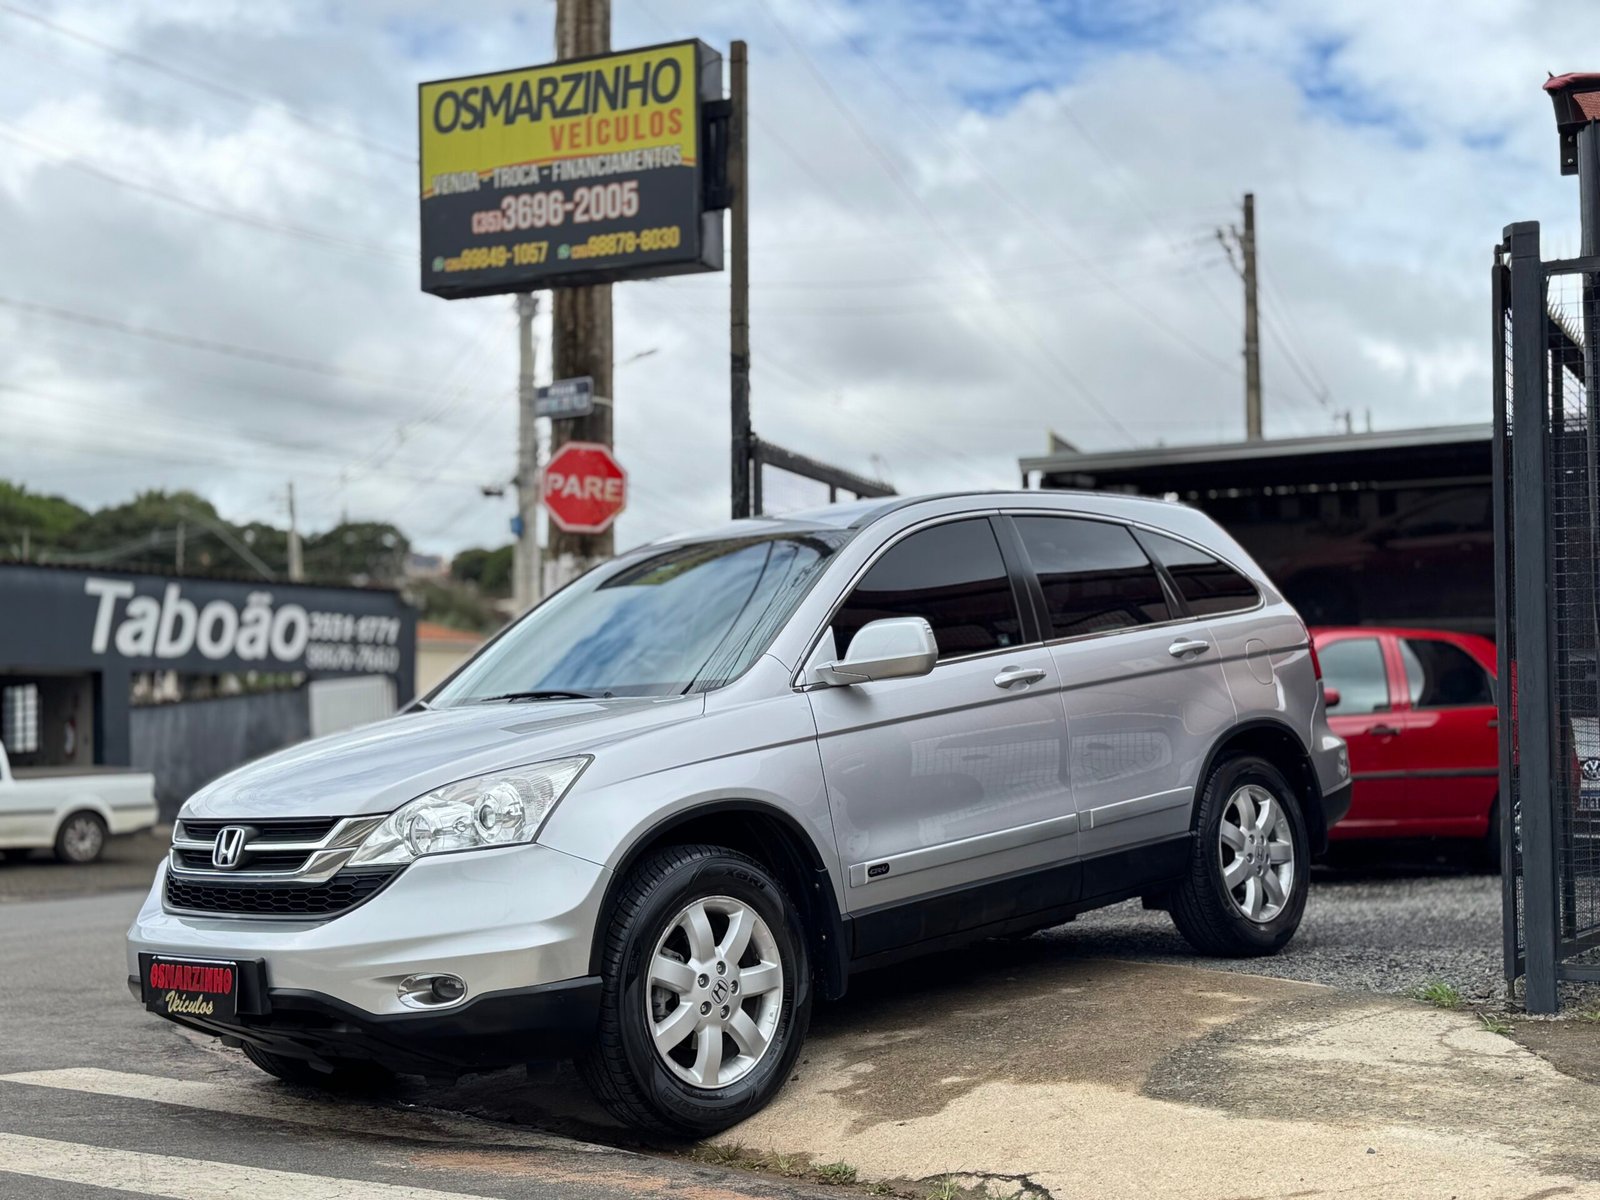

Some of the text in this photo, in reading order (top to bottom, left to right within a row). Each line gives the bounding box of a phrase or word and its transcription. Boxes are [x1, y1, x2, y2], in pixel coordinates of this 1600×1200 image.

[433, 57, 682, 135] OSMARZINHO
[549, 107, 683, 152] VEÍCULOS
[432, 171, 480, 195] VENDA
[493, 164, 540, 190] TROCA
[551, 145, 682, 182] FINANCIAMENTOS
[547, 473, 622, 500] PARE
[84, 577, 309, 662] Taboão
[151, 963, 232, 994] OSMARZINHO
